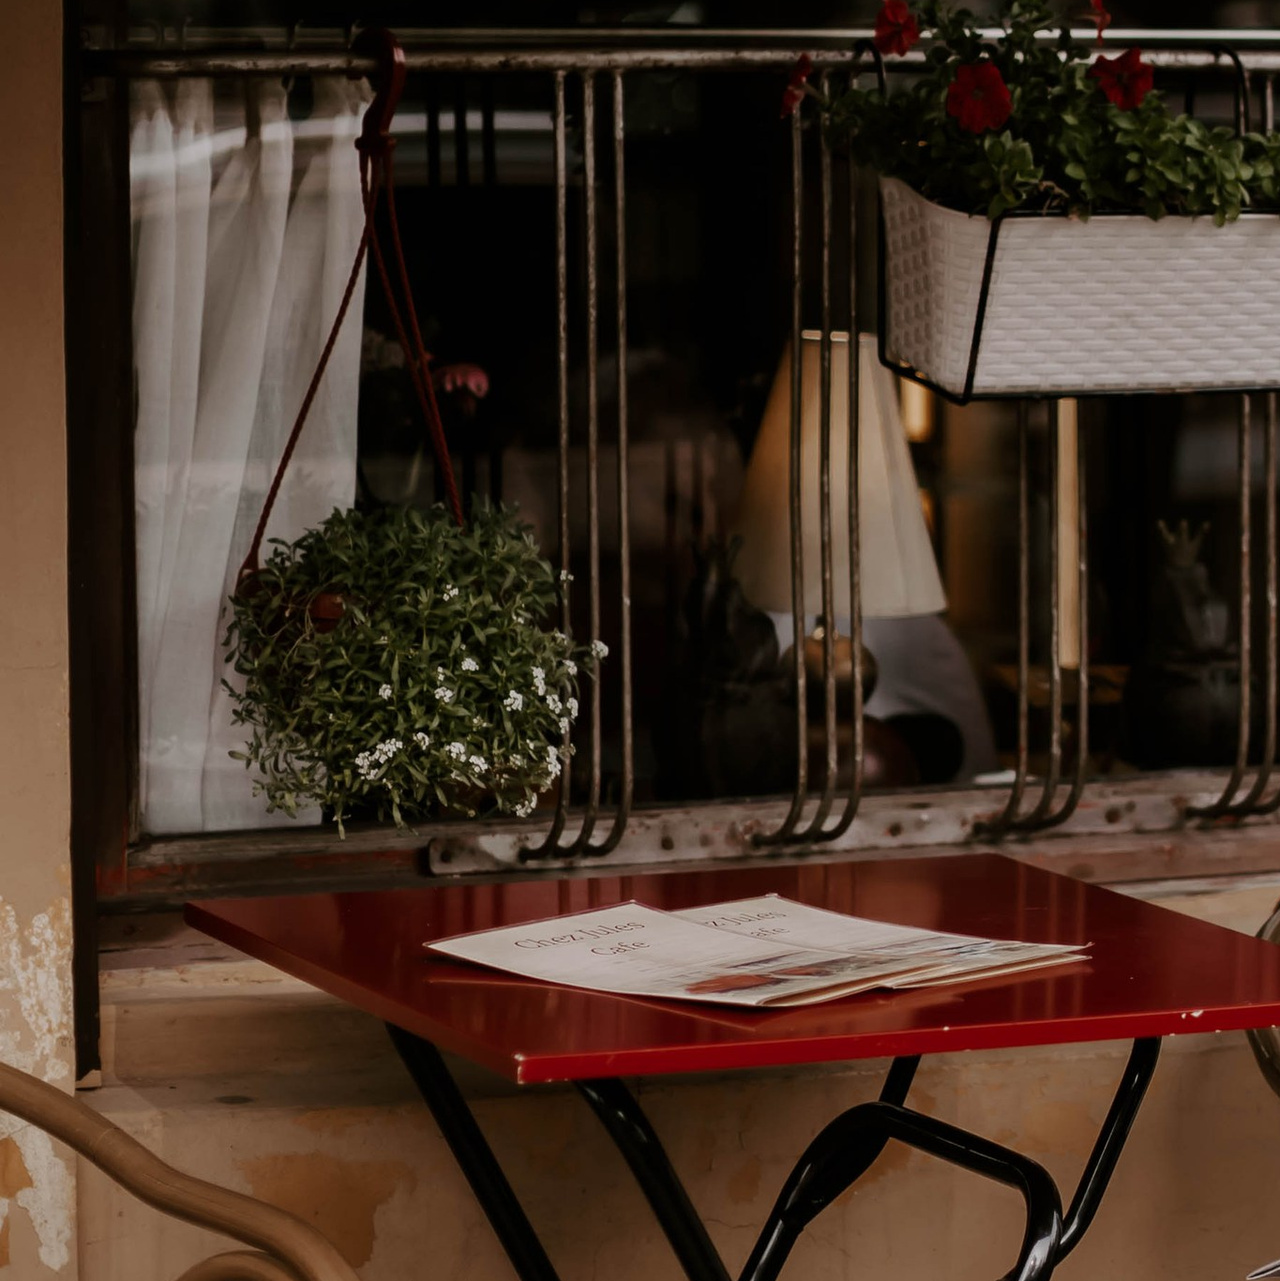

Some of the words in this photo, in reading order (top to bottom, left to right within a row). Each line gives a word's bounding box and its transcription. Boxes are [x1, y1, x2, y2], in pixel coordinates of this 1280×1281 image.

[716, 911, 787, 926] Jules
[514, 933, 584, 950] Chez
[575, 921, 646, 940] Jules
[750, 927, 791, 937] afe
